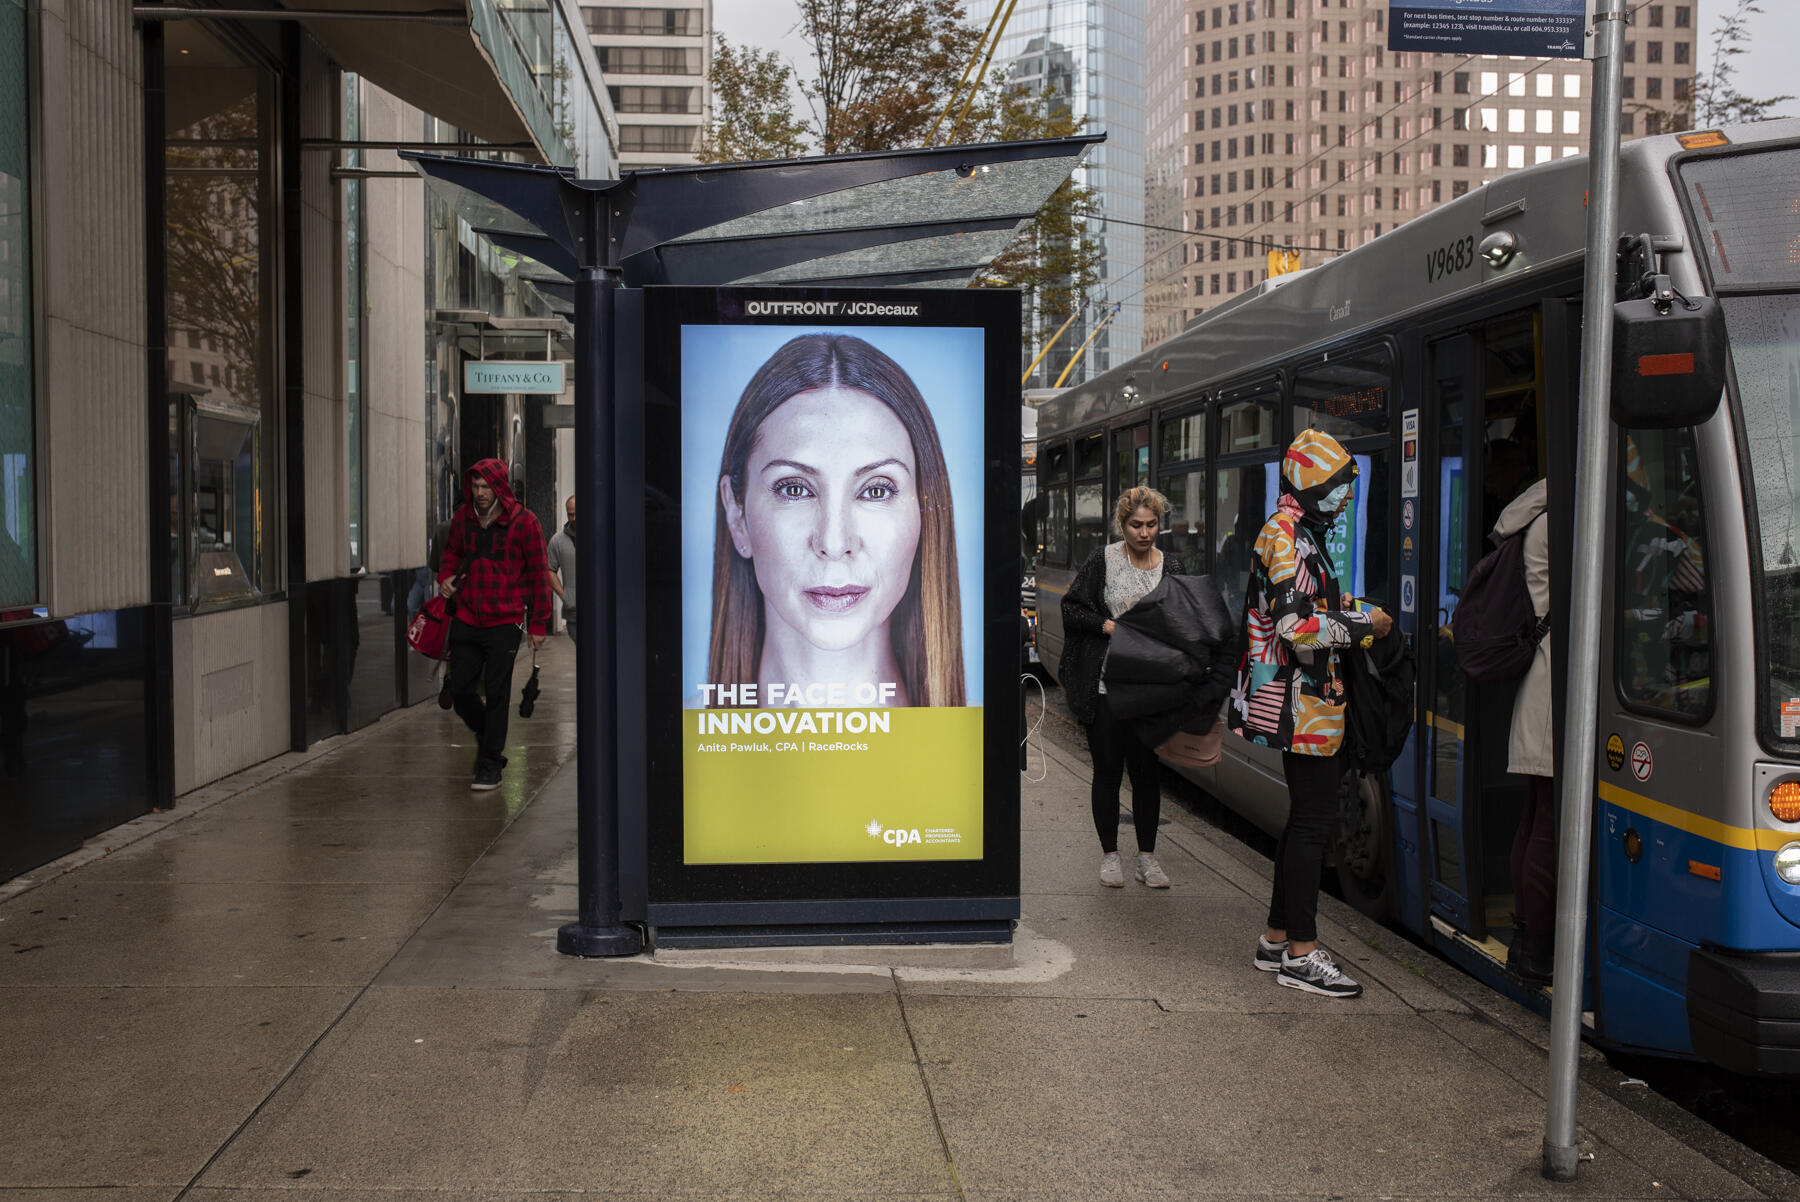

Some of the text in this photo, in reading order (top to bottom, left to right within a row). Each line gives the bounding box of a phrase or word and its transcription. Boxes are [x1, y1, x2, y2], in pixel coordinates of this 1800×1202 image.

[1439, 13, 1456, 21] times,
[1469, 14, 1481, 22] stop
[1404, 22, 1430, 30] (example:
[1478, 24, 1513, 32] translink.ca,
[1427, 235, 1474, 284] V9683
[747, 301, 839, 315] OUTFRONT
[847, 302, 919, 316] JCDecaux
[475, 372, 521, 383] TIFFANY
[1405, 420, 1416, 431] VISA
[697, 682, 897, 706] THE FACE OF
[698, 711, 890, 735] INNOVATION
[697, 742, 727, 753] Anita
[730, 742, 772, 753] Pawluk,
[775, 742, 799, 752] CPA
[808, 741, 868, 752] RaceRocks
